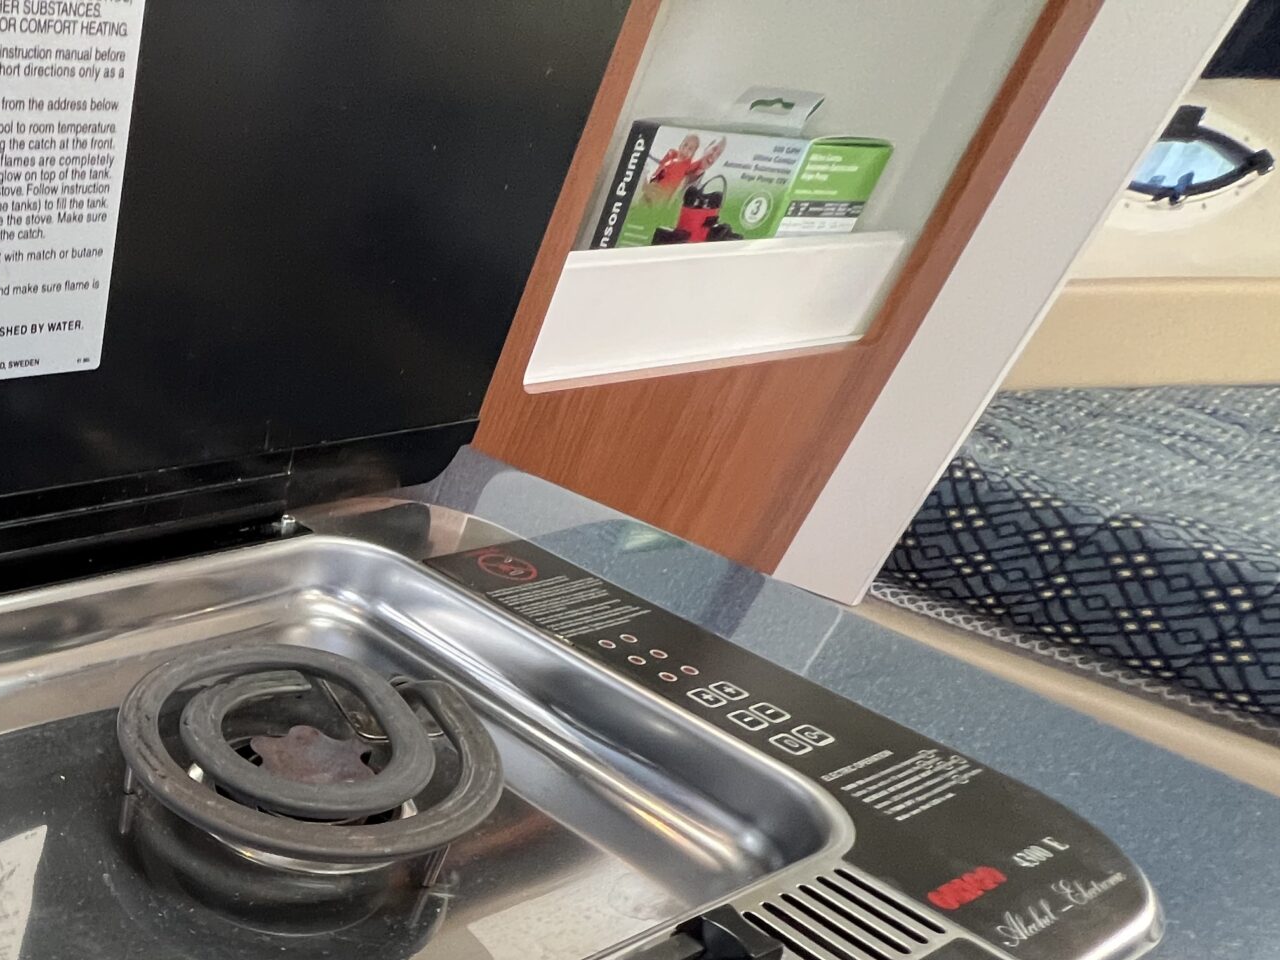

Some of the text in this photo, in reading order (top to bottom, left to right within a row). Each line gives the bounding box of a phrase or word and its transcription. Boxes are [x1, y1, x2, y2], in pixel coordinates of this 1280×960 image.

[19, 18, 76, 34] COMFORT
[0, 44, 52, 59] instruction
[54, 46, 92, 60] manual
[94, 47, 125, 62] before
[23, 63, 75, 77] directions
[78, 64, 100, 81] only
[103, 68, 115, 78] as
[118, 68, 124, 78] a
[1, 96, 25, 110] from
[28, 97, 44, 110] the
[47, 97, 87, 110] address
[16, 120, 26, 133] to
[28, 123, 54, 133] room
[616, 139, 645, 196] Pump
[0, 229, 15, 242] the
[4, 250, 24, 263] with
[26, 248, 56, 262] match
[58, 250, 68, 259] or
[70, 245, 103, 259] butane
[12, 281, 38, 295] make
[41, 282, 62, 292] sure
[64, 278, 89, 291] flame
[92, 277, 99, 289] is
[30, 323, 43, 334] BY
[8, 358, 39, 369] SWEDEN
[996, 899, 1059, 947] Alcohol
